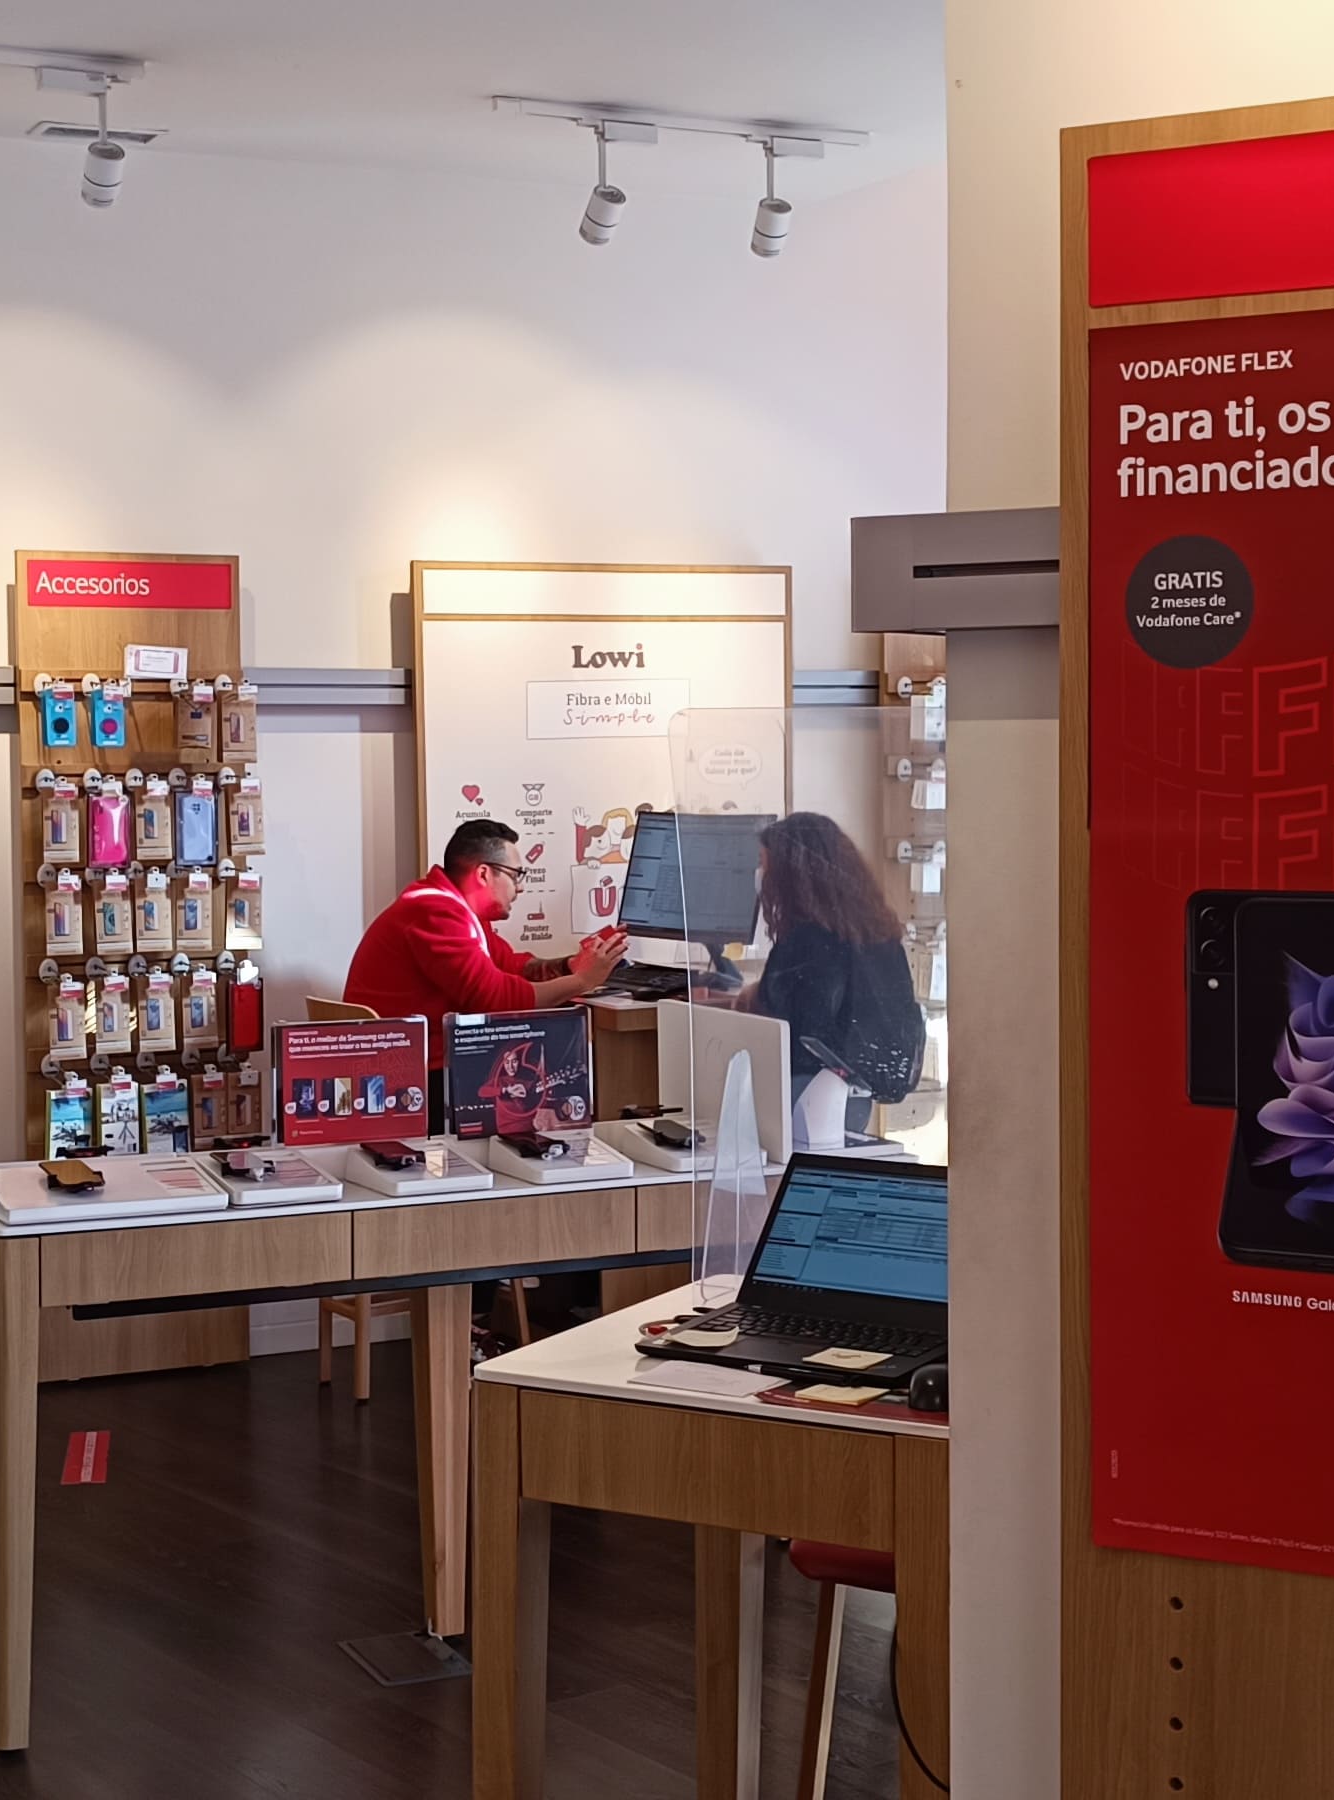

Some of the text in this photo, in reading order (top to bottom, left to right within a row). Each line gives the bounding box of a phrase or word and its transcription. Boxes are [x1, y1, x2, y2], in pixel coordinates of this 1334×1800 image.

[1120, 350, 1293, 381] VODAFONE FLEX
[1119, 404, 1213, 445] Para
[1224, 396, 1266, 442] ti,
[1278, 400, 1331, 434] os
[35, 570, 150, 595] Accesorios
[1154, 571, 1223, 591] GRATIS
[1151, 594, 1226, 609] 2 meses de
[1136, 614, 1201, 628] Vodafone
[571, 643, 645, 669] Lowi
[567, 692, 601, 706] Fibra
[604, 695, 612, 705] e
[455, 809, 491, 818] Acumula
[515, 808, 553, 818] Comparte
[525, 874, 546, 883] Final
[523, 924, 549, 933] Router
[1232, 1290, 1302, 1308] SAMSUNG
